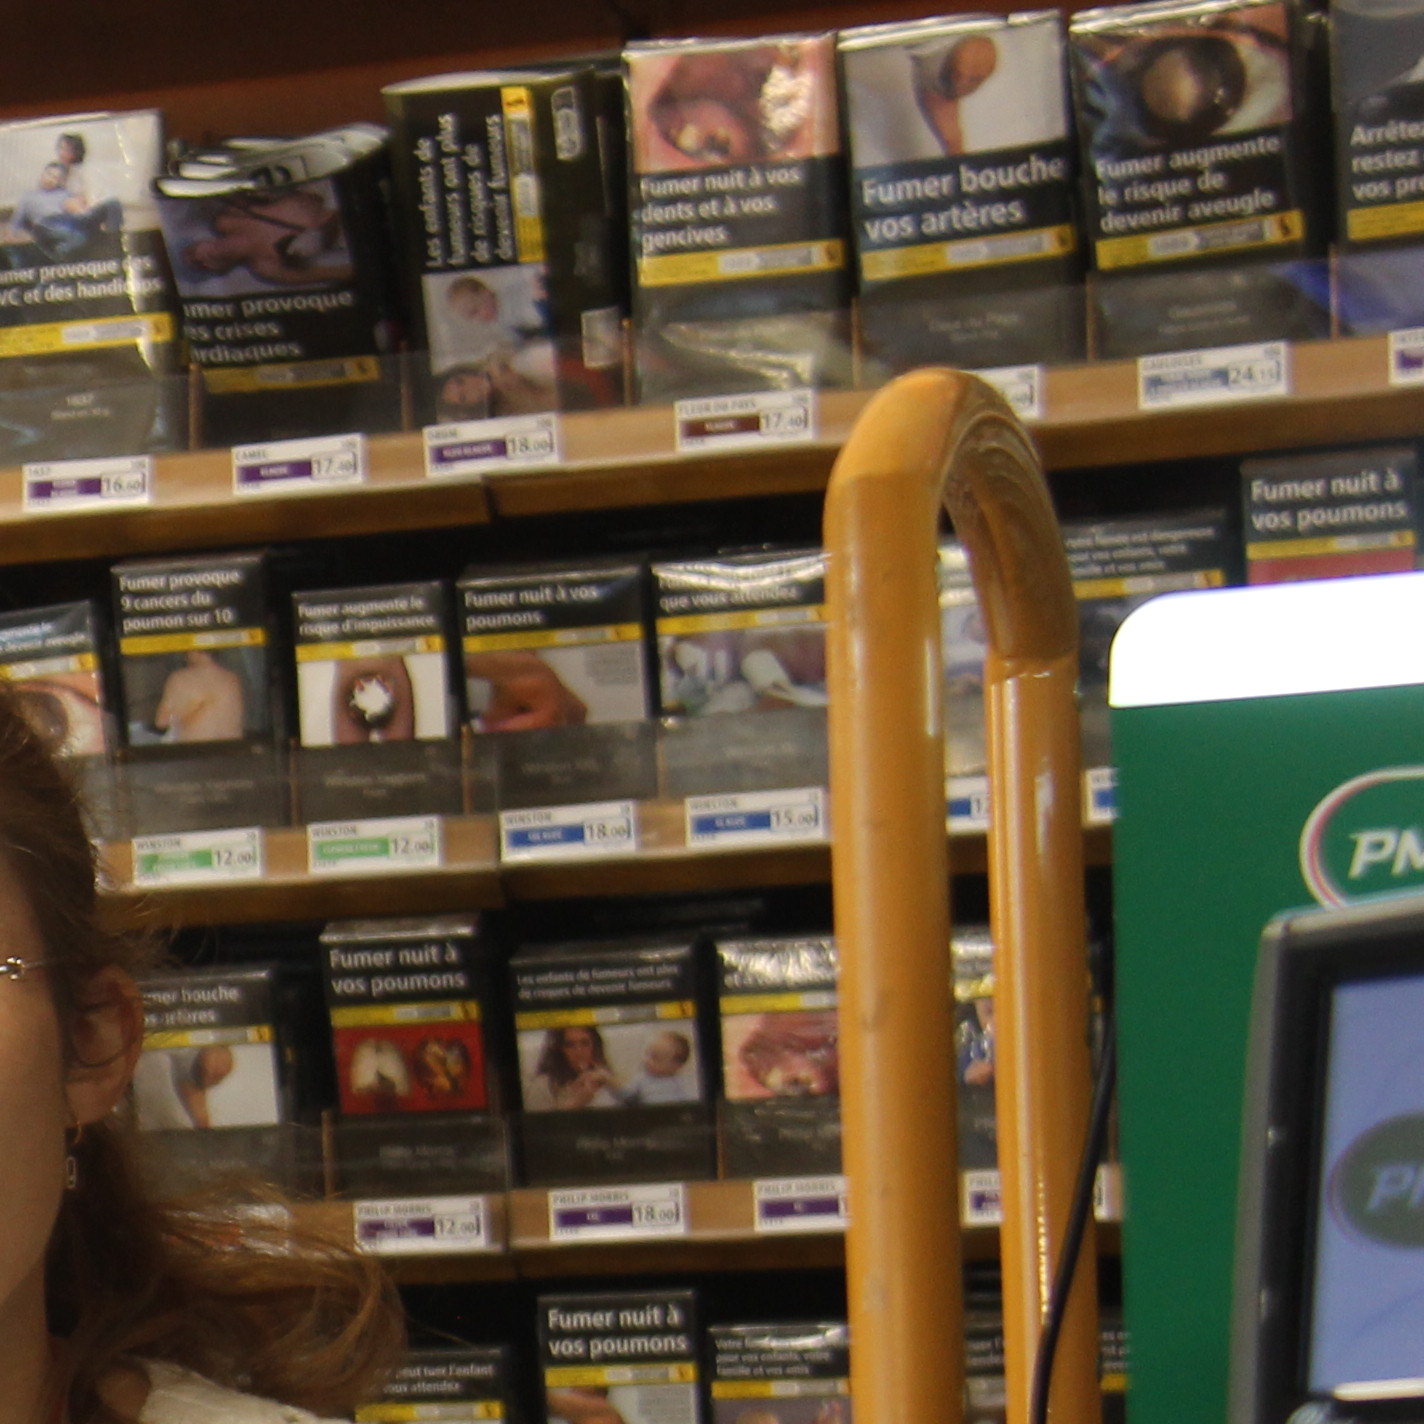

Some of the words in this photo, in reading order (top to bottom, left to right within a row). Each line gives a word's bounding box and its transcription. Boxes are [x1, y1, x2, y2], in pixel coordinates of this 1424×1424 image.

[1096, 156, 1163, 180] Fumer
[1168, 134, 1282, 168] augmente
[861, 173, 953, 205] Fumer
[959, 157, 1065, 190] bouche
[864, 214, 913, 241] vos
[921, 200, 1026, 235] artères
[1100, 207, 1183, 234] devenir
[1188, 189, 1274, 222] aveugle
[641, 225, 728, 248] gencives
[1250, 479, 1324, 502] Fumer
[1330, 471, 1379, 495] nuit
[1384, 469, 1400, 492] à
[1251, 512, 1290, 531] vos
[1297, 501, 1407, 531] poumons
[119, 574, 167, 591] Fumer
[169, 569, 240, 590] provoque
[123, 613, 179, 634] poumon
[178, 612, 210, 626] sur
[214, 608, 232, 624] 10
[298, 620, 337, 636] risque
[341, 613, 436, 634] d'impuissance
[466, 609, 542, 632] poumons
[329, 948, 395, 970] Fumer
[398, 945, 440, 966] nuit
[445, 943, 458, 963] à
[331, 976, 368, 995] vos
[371, 971, 465, 997] poumons
[549, 1337, 584, 1358] vos
[590, 1331, 688, 1360] poumons
